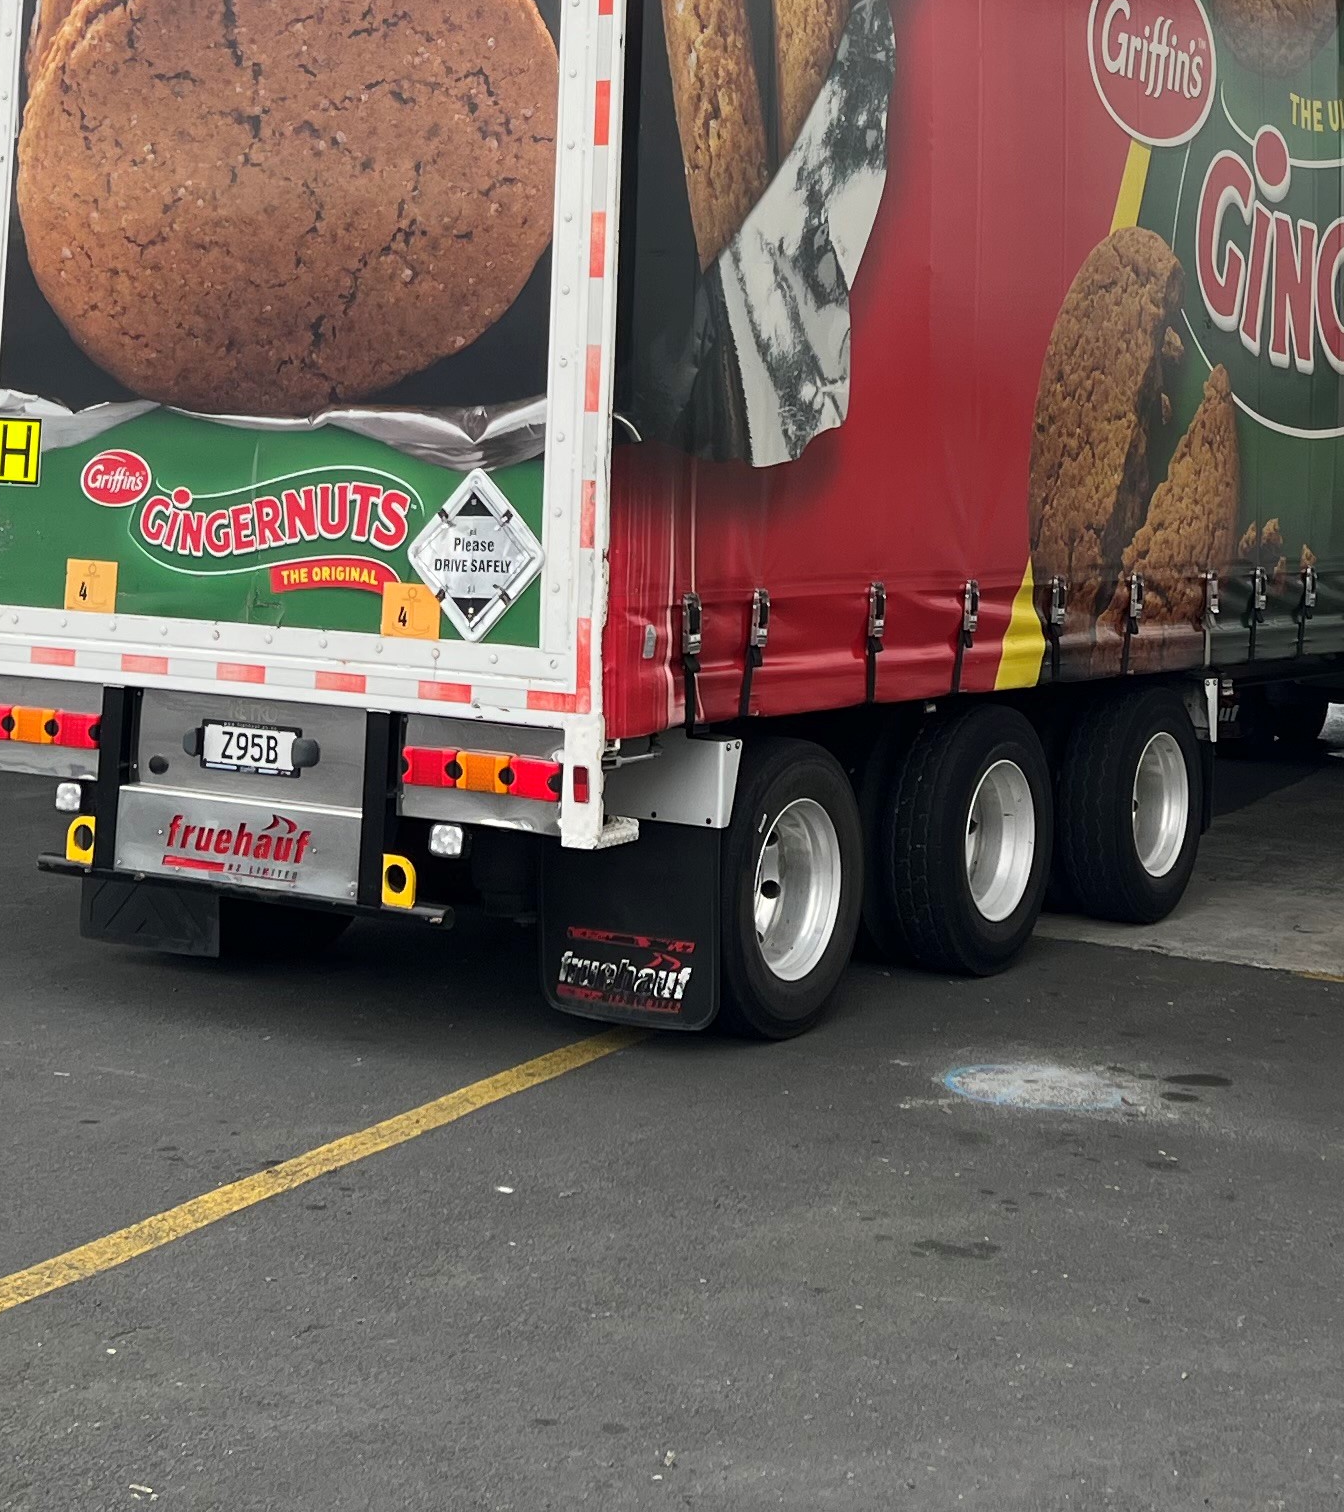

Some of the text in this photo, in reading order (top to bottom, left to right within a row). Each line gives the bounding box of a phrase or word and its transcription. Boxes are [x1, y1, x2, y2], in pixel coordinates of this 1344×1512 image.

[1290, 92, 1324, 133] THE
[0, 424, 33, 479] H
[87, 463, 144, 494] Griffin's
[453, 537, 495, 553] Please
[280, 566, 379, 586] THE ORIGINAL
[434, 558, 512, 574] DRIVE SAFELY
[78, 581, 88, 601] 4
[397, 606, 408, 627] 4
[220, 730, 279, 764] Z95B
[166, 814, 312, 865] fruehauf
[558, 950, 693, 1000] fruehauf
